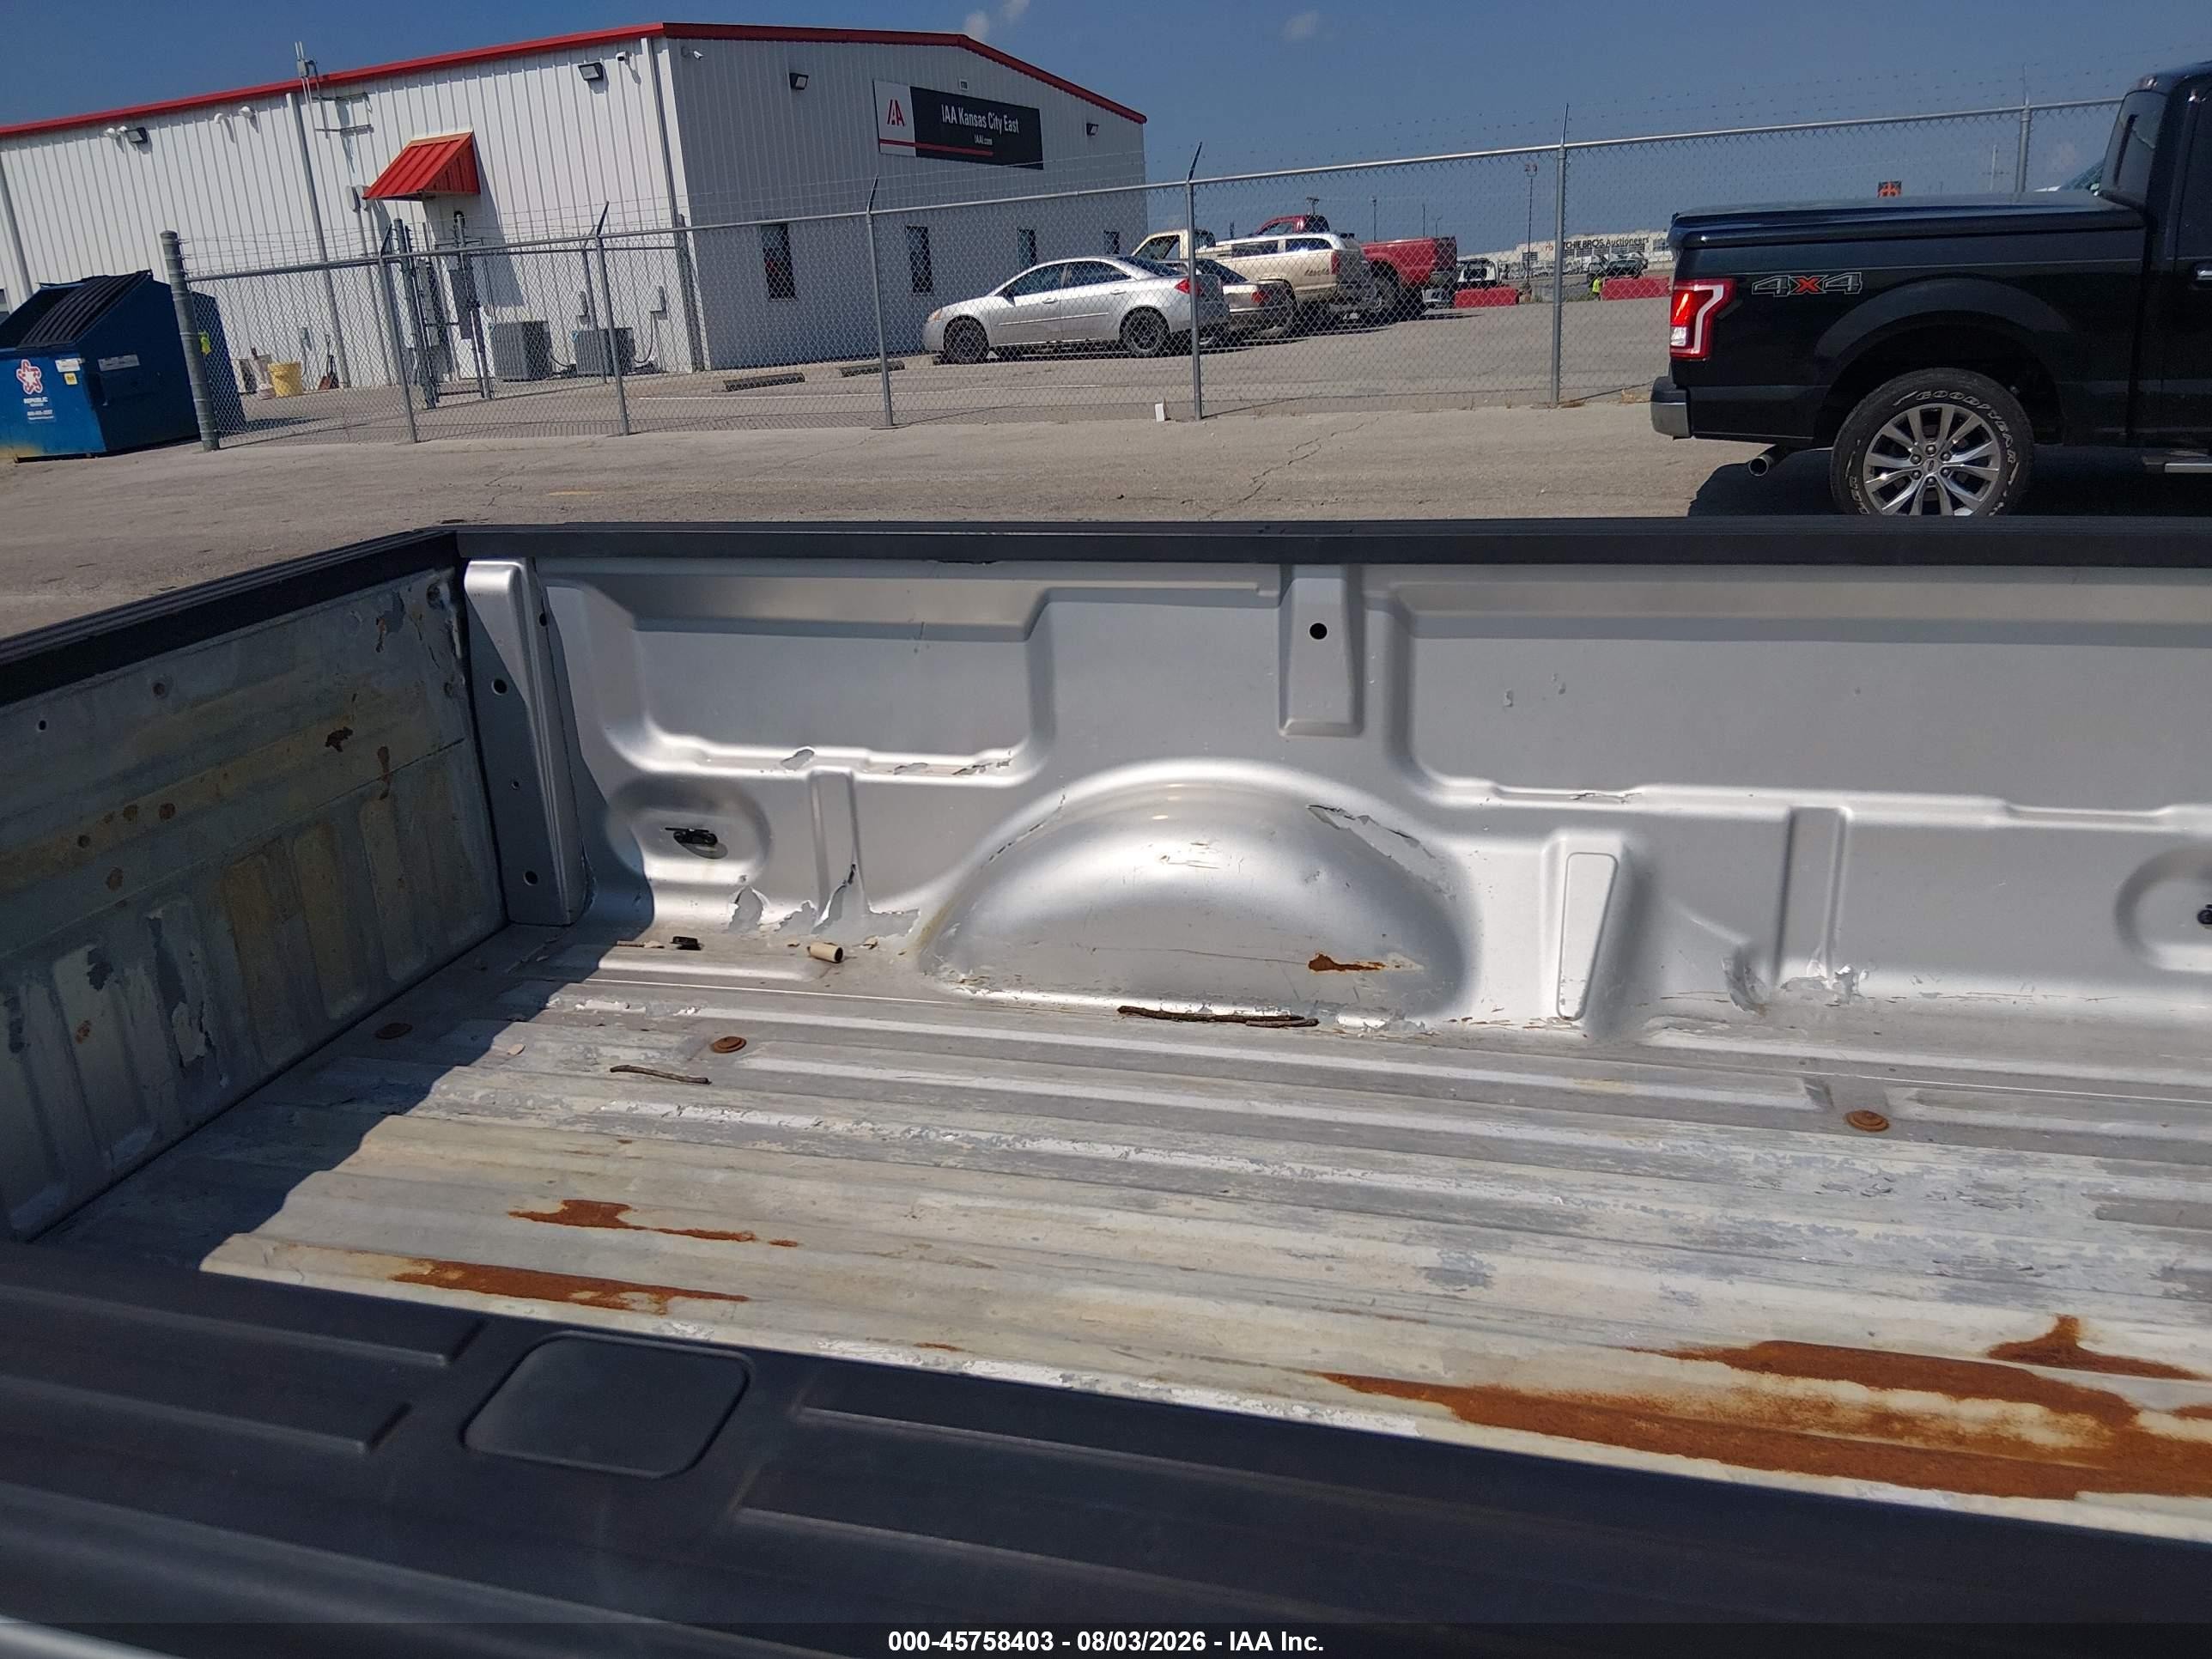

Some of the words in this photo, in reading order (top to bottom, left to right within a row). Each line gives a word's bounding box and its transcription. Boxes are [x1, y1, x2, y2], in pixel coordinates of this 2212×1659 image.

[941, 104, 958, 125] IAA
[958, 106, 988, 129] Kansas
[988, 112, 1003, 136] City
[1003, 114, 1019, 133] East
[1606, 237, 1650, 248] Auctioneers
